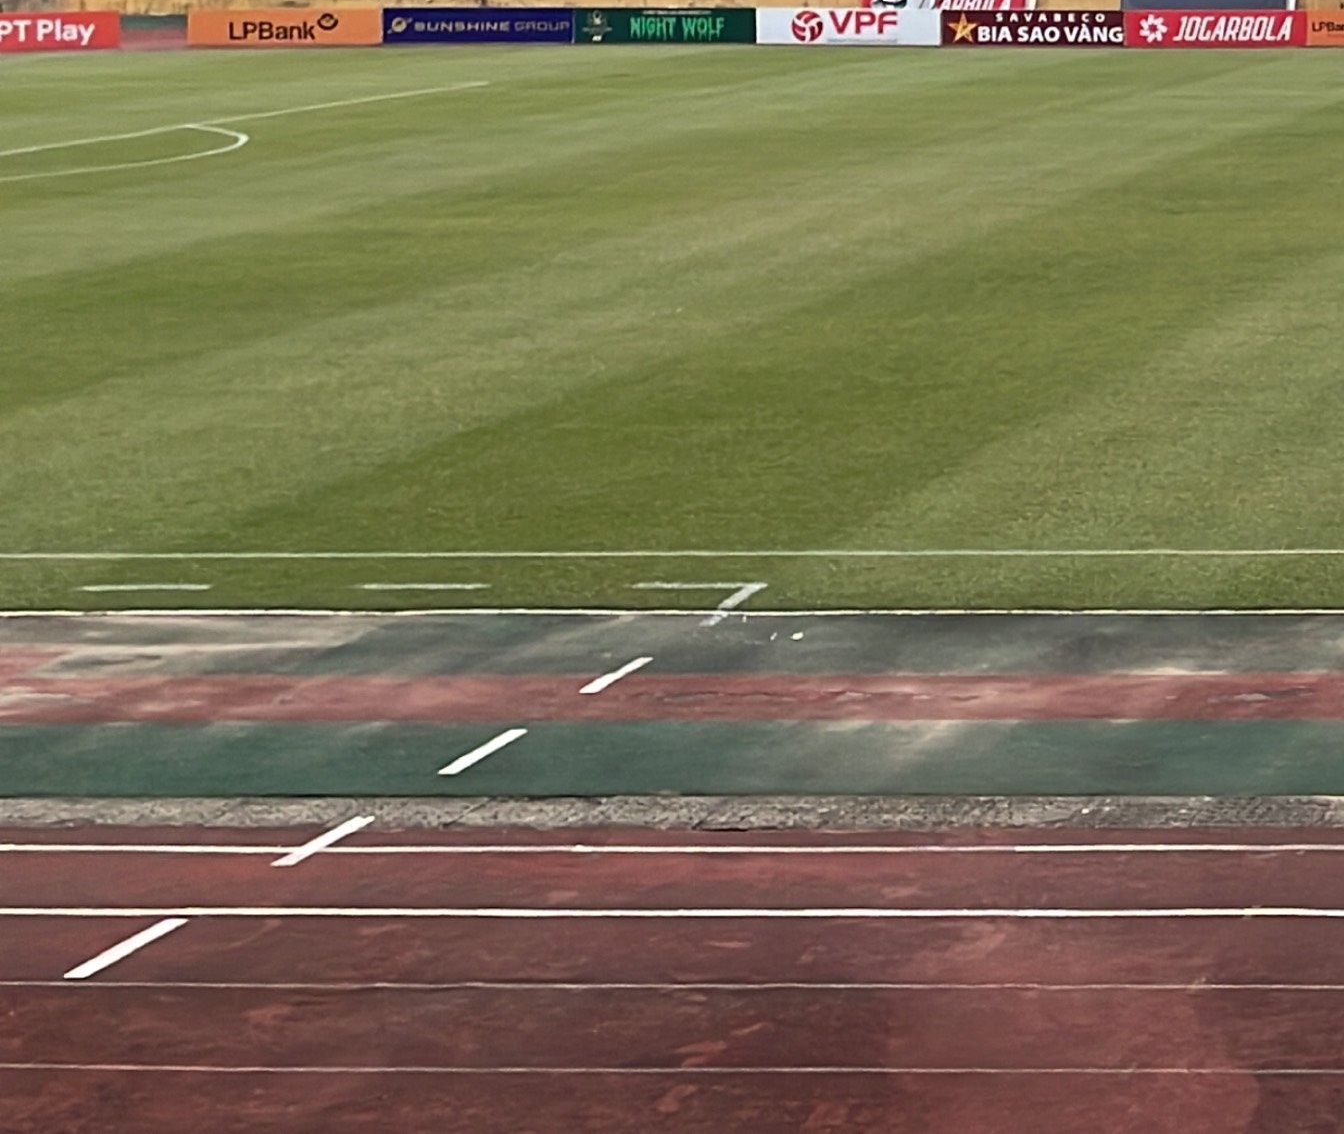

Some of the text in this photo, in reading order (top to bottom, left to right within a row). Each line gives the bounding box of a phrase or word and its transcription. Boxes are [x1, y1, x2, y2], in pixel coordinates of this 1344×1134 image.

[414, 22, 571, 32] SUNSHINE GROUP
[629, 17, 726, 40] NIGHT WOLF
[829, 10, 899, 34] VPF
[995, 13, 1106, 23] SAVABECO
[1173, 16, 1293, 42] JOGARBOLA
[0, 19, 95, 45] PT Play
[229, 22, 315, 41] LPBank
[977, 21, 1124, 43] BIA SAO VÀNG
